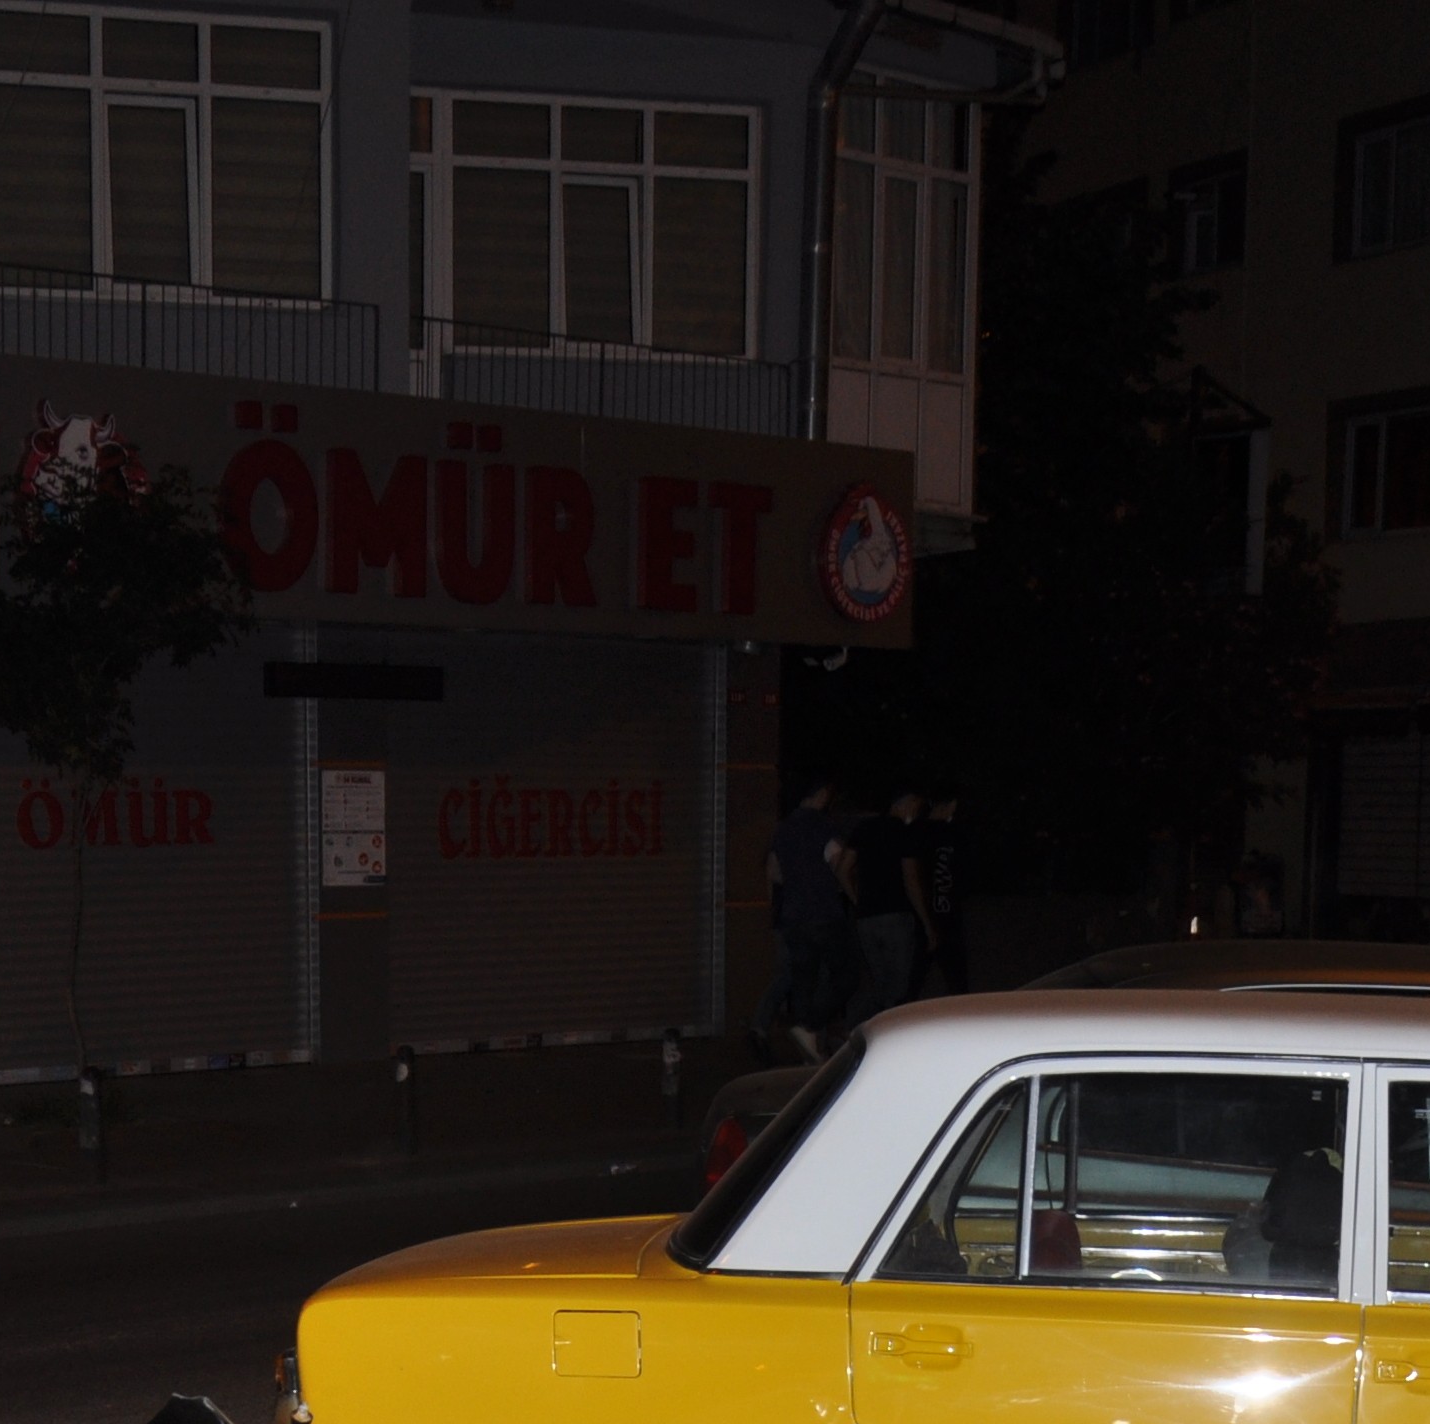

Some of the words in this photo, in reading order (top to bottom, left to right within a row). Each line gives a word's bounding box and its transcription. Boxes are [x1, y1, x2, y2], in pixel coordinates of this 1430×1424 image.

[219, 400, 597, 607] ÖMÜR
[637, 476, 773, 615] ET
[17, 777, 215, 849] ÖMÜR
[437, 774, 665, 860] CİĞERCİSİ
